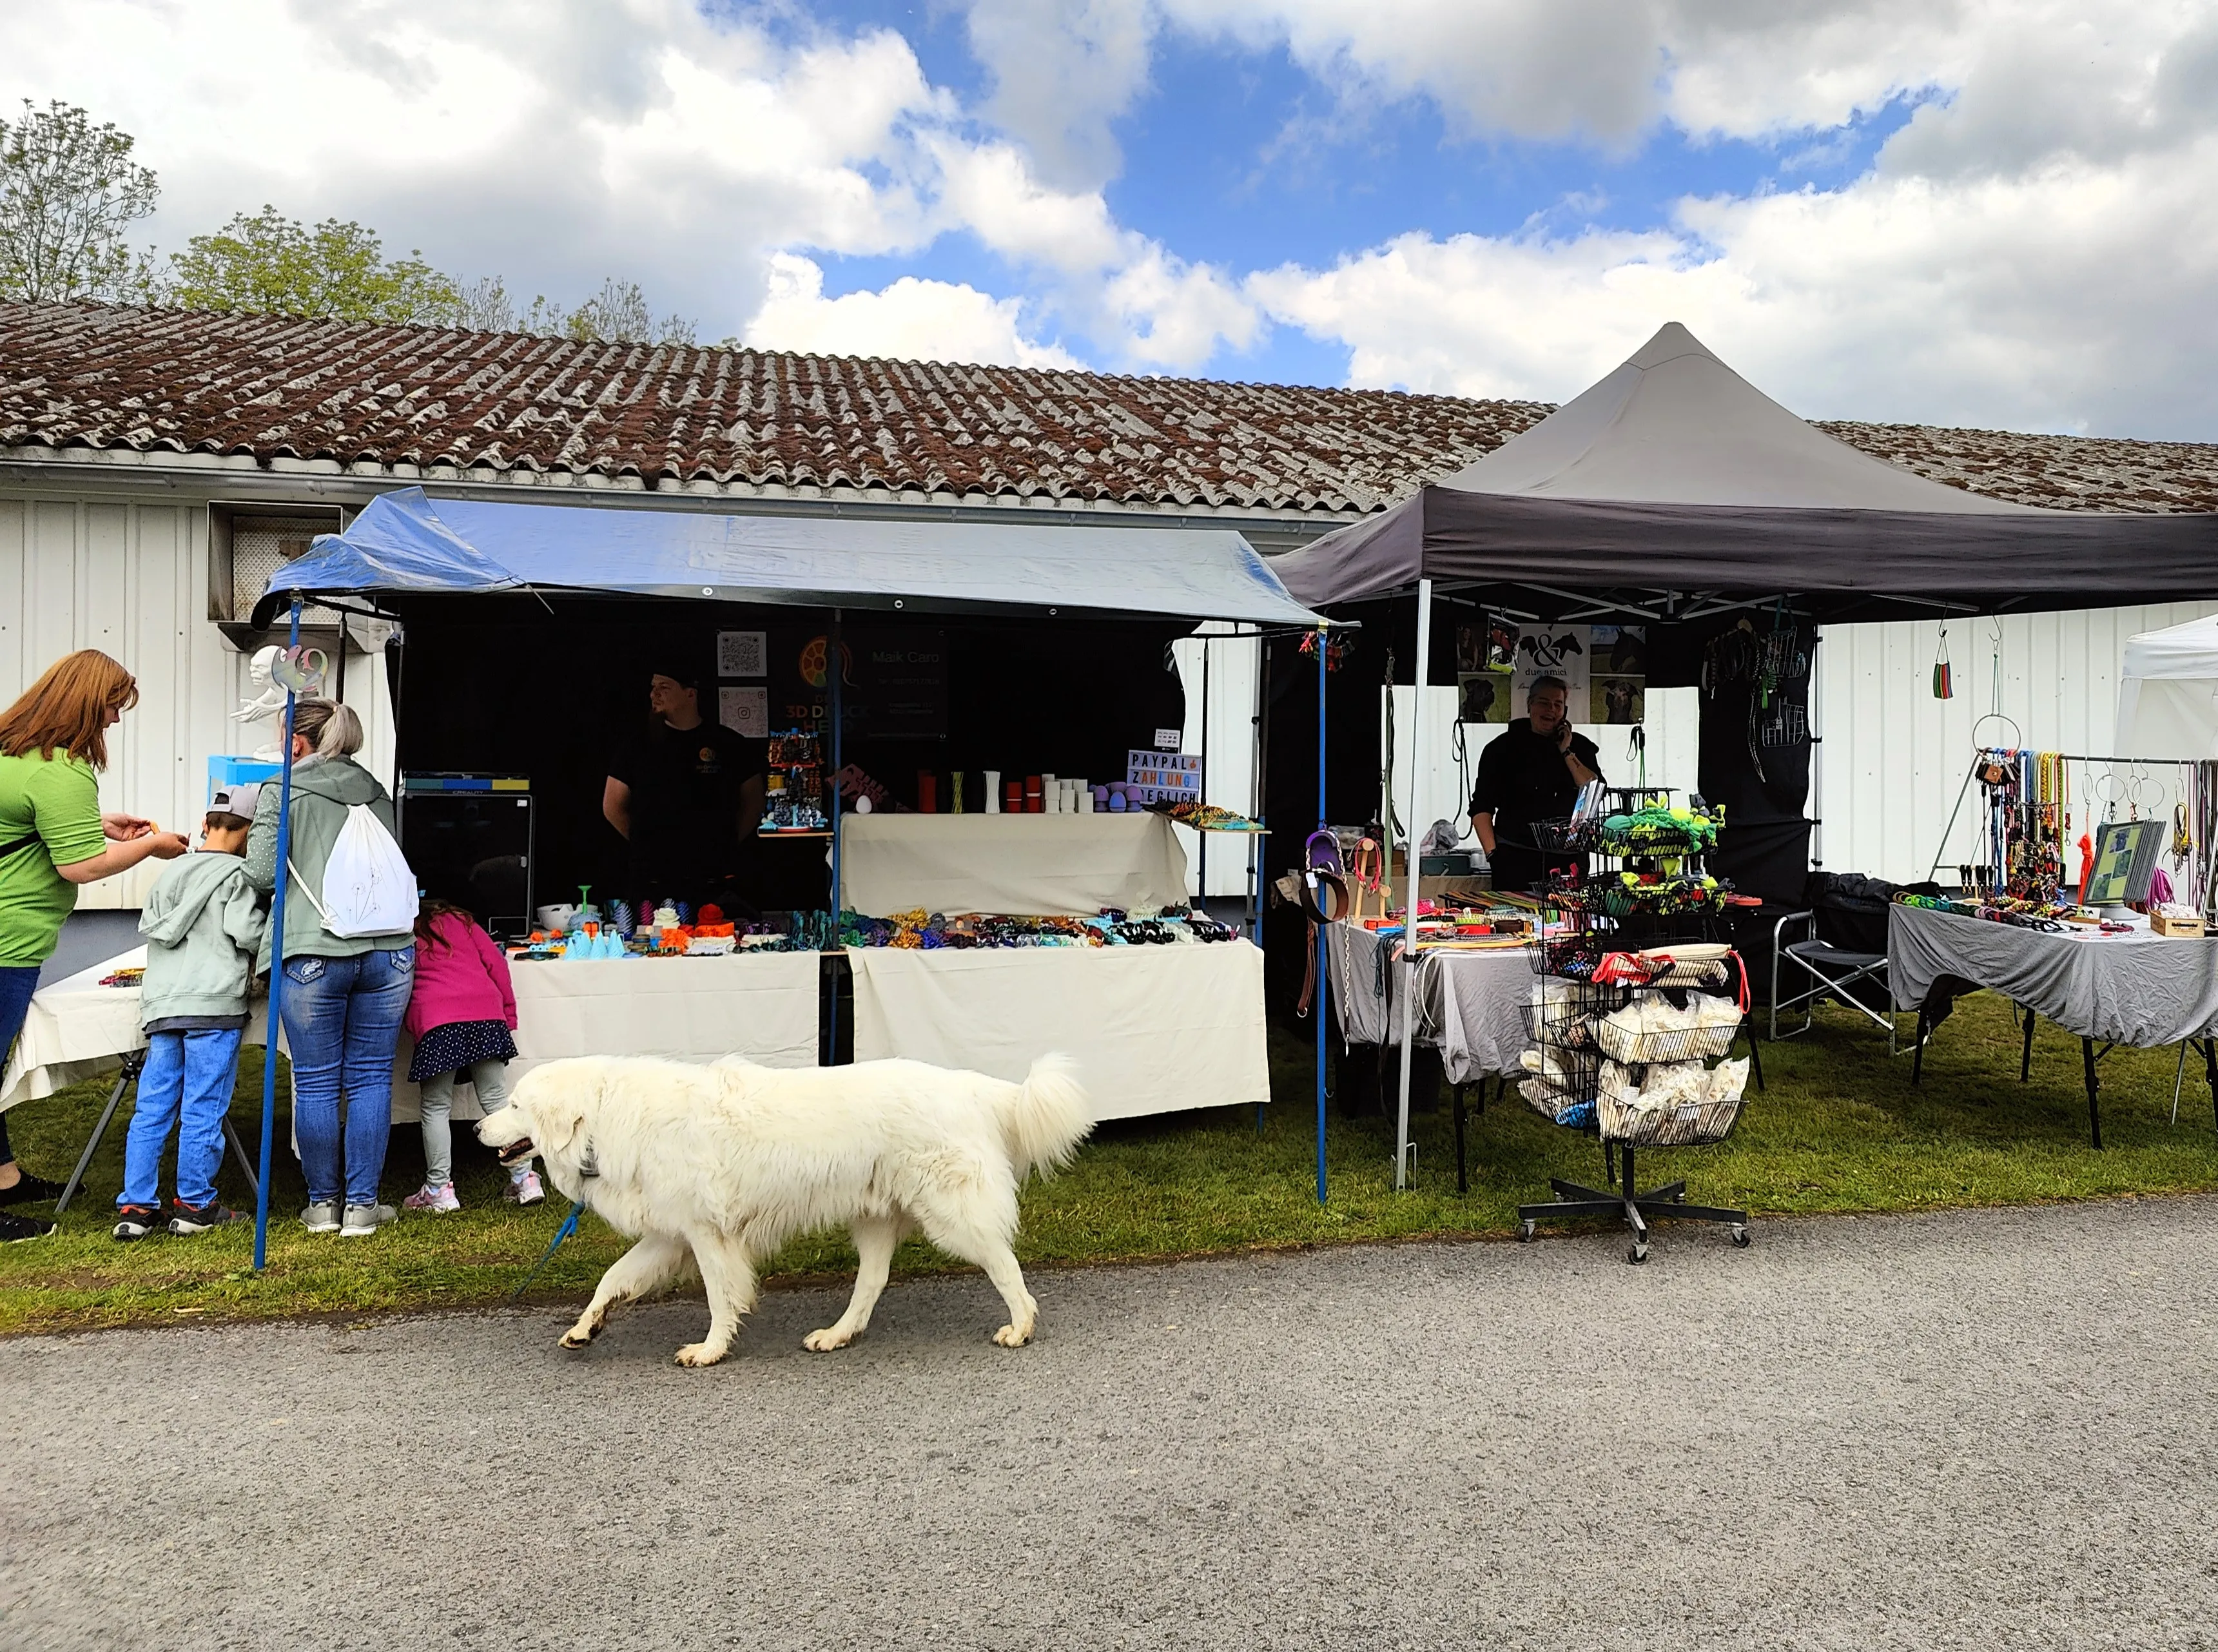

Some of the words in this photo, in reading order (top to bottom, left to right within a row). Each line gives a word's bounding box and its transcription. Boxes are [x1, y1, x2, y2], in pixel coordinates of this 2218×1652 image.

[872, 650, 904, 663] Maik
[907, 651, 940, 663] Caro
[785, 705, 808, 718] 3D
[1133, 754, 1187, 770] PAYPAL
[1133, 772, 1190, 787] ZAHLUNG
